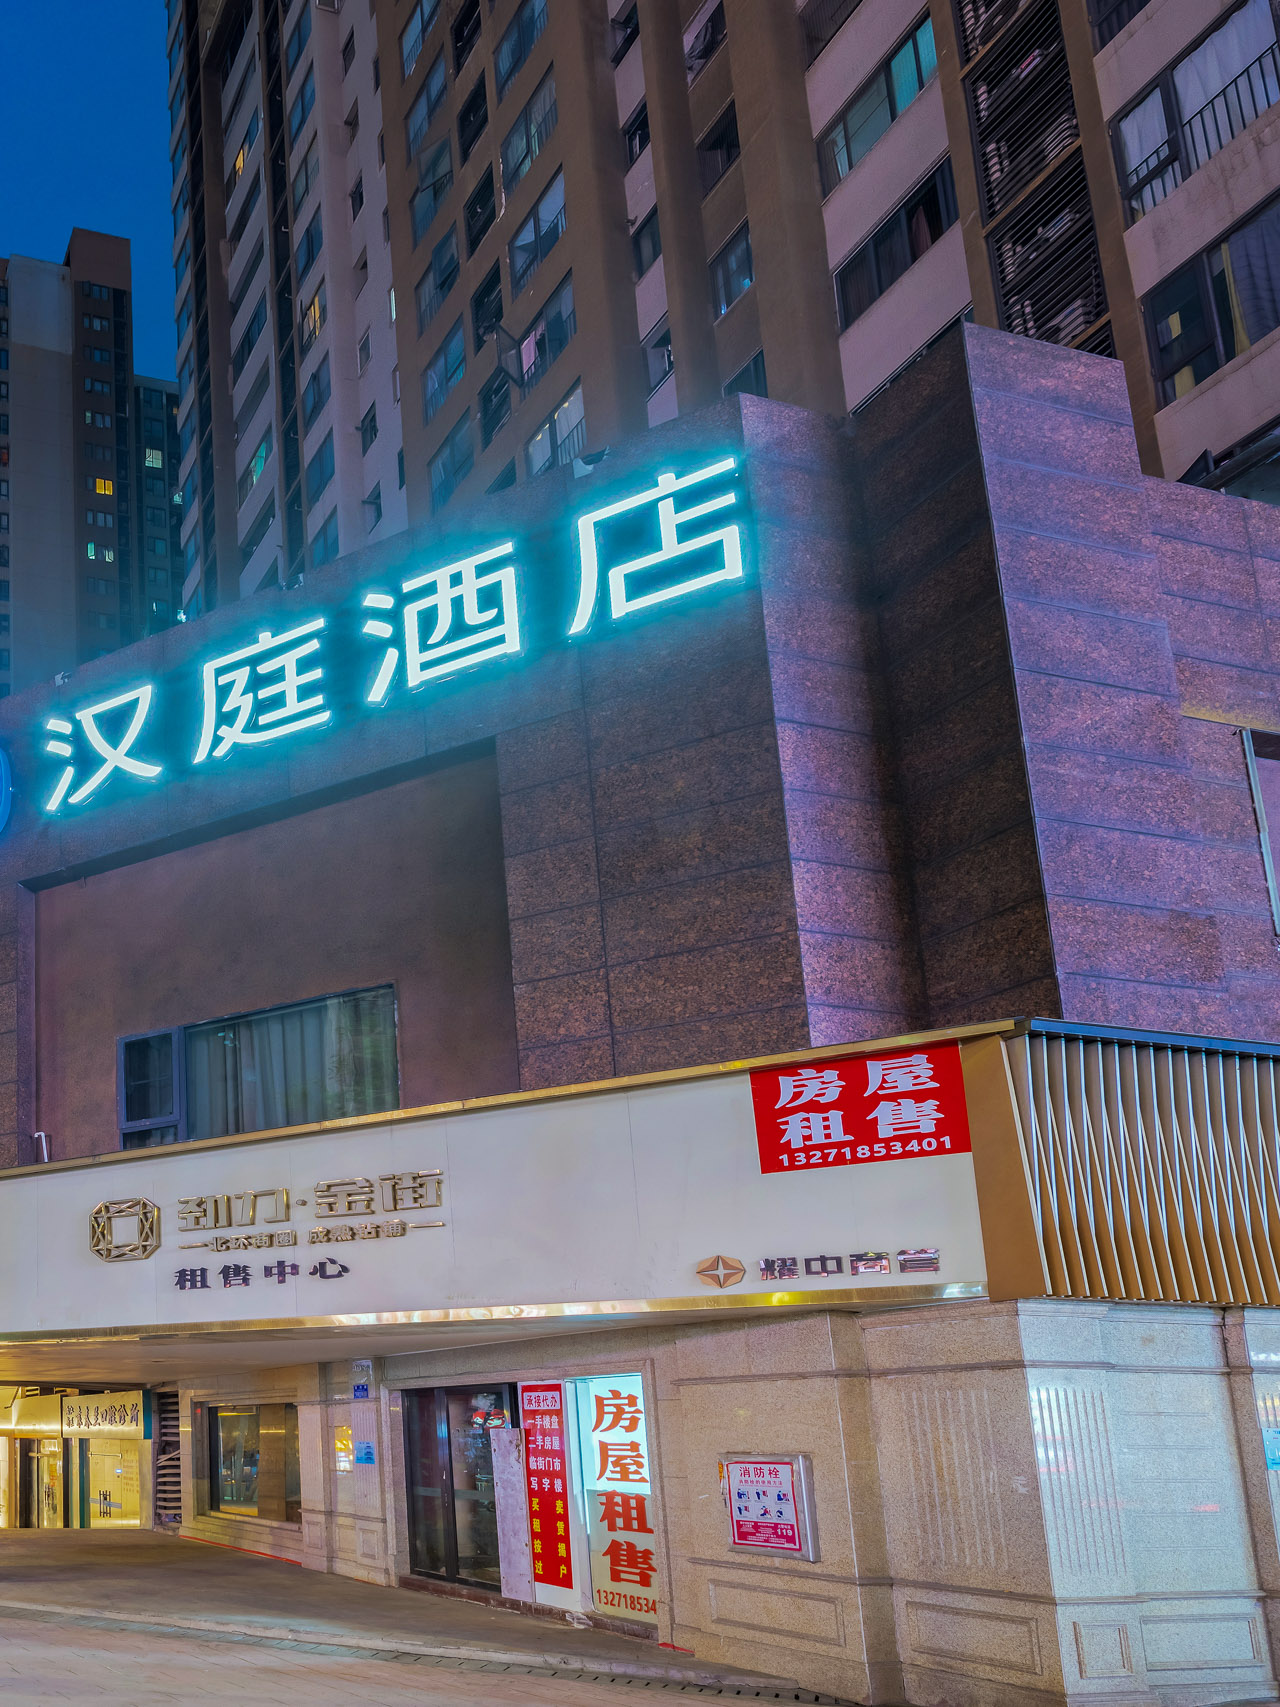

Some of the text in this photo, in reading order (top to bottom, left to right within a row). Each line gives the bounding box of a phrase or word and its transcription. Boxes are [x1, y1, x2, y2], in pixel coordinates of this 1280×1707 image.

[45, 457, 744, 813] 汉庭酒店
[774, 1054, 940, 1109] 房屋
[777, 1099, 944, 1149] 租售
[779, 1136, 952, 1167] 13271853401
[174, 1257, 350, 1290] 租售中心
[526, 1394, 558, 1408] 承接代办
[527, 1415, 559, 1429] 一手楼盘
[528, 1436, 560, 1450] 二手房屋
[529, 1456, 561, 1471] 临街门市
[739, 1466, 780, 1479] 消防栓
[530, 1477, 562, 1493] 写字楼
[592, 1389, 658, 1588] 房屋租售
[777, 1528, 793, 1536] 119
[596, 1588, 657, 1615] 132718534
